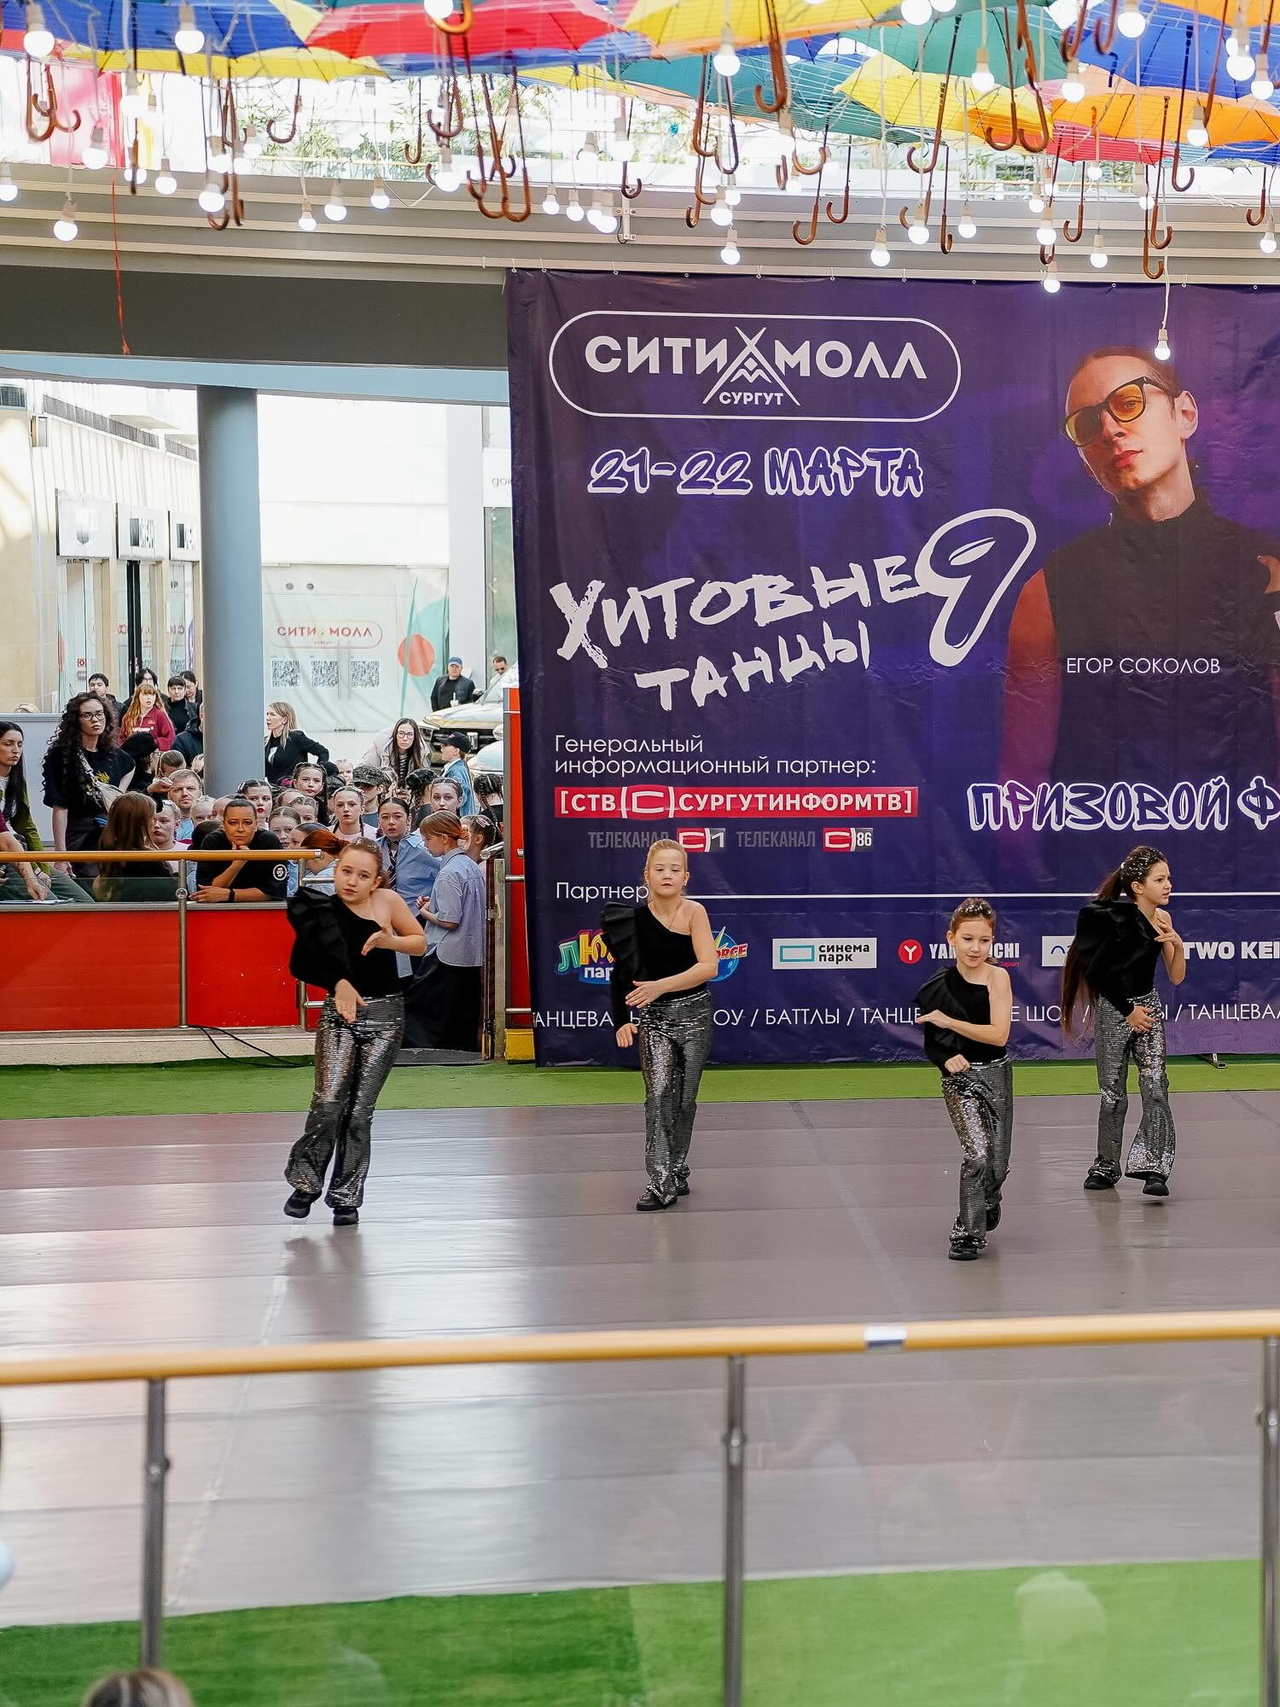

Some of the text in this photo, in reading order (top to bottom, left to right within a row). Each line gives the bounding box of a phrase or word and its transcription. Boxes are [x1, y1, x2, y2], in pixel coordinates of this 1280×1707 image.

[584, 335, 928, 379] СИТИ МОЛЛ
[718, 391, 784, 405] СУРГУТ
[587, 447, 925, 497] 21-22 МАРТА
[277, 626, 373, 637] СИТИ МОЛЛ
[1066, 658, 1221, 675] ЕГОР СОКОЛОВ
[555, 735, 704, 756] Генеральный
[555, 756, 876, 776] информационный партнер:
[967, 776, 1230, 832] ПРИЗОВОЙ
[736, 831, 816, 848] ТЕЛЕКАНАЛ
[556, 882, 649, 903] Партнер
[818, 943, 870, 955] синема
[818, 953, 854, 965] парк
[713, 1009, 744, 1026] ОУ
[765, 1008, 840, 1025] БАТТЛЫ
[1026, 1005, 1062, 1022] ШО
